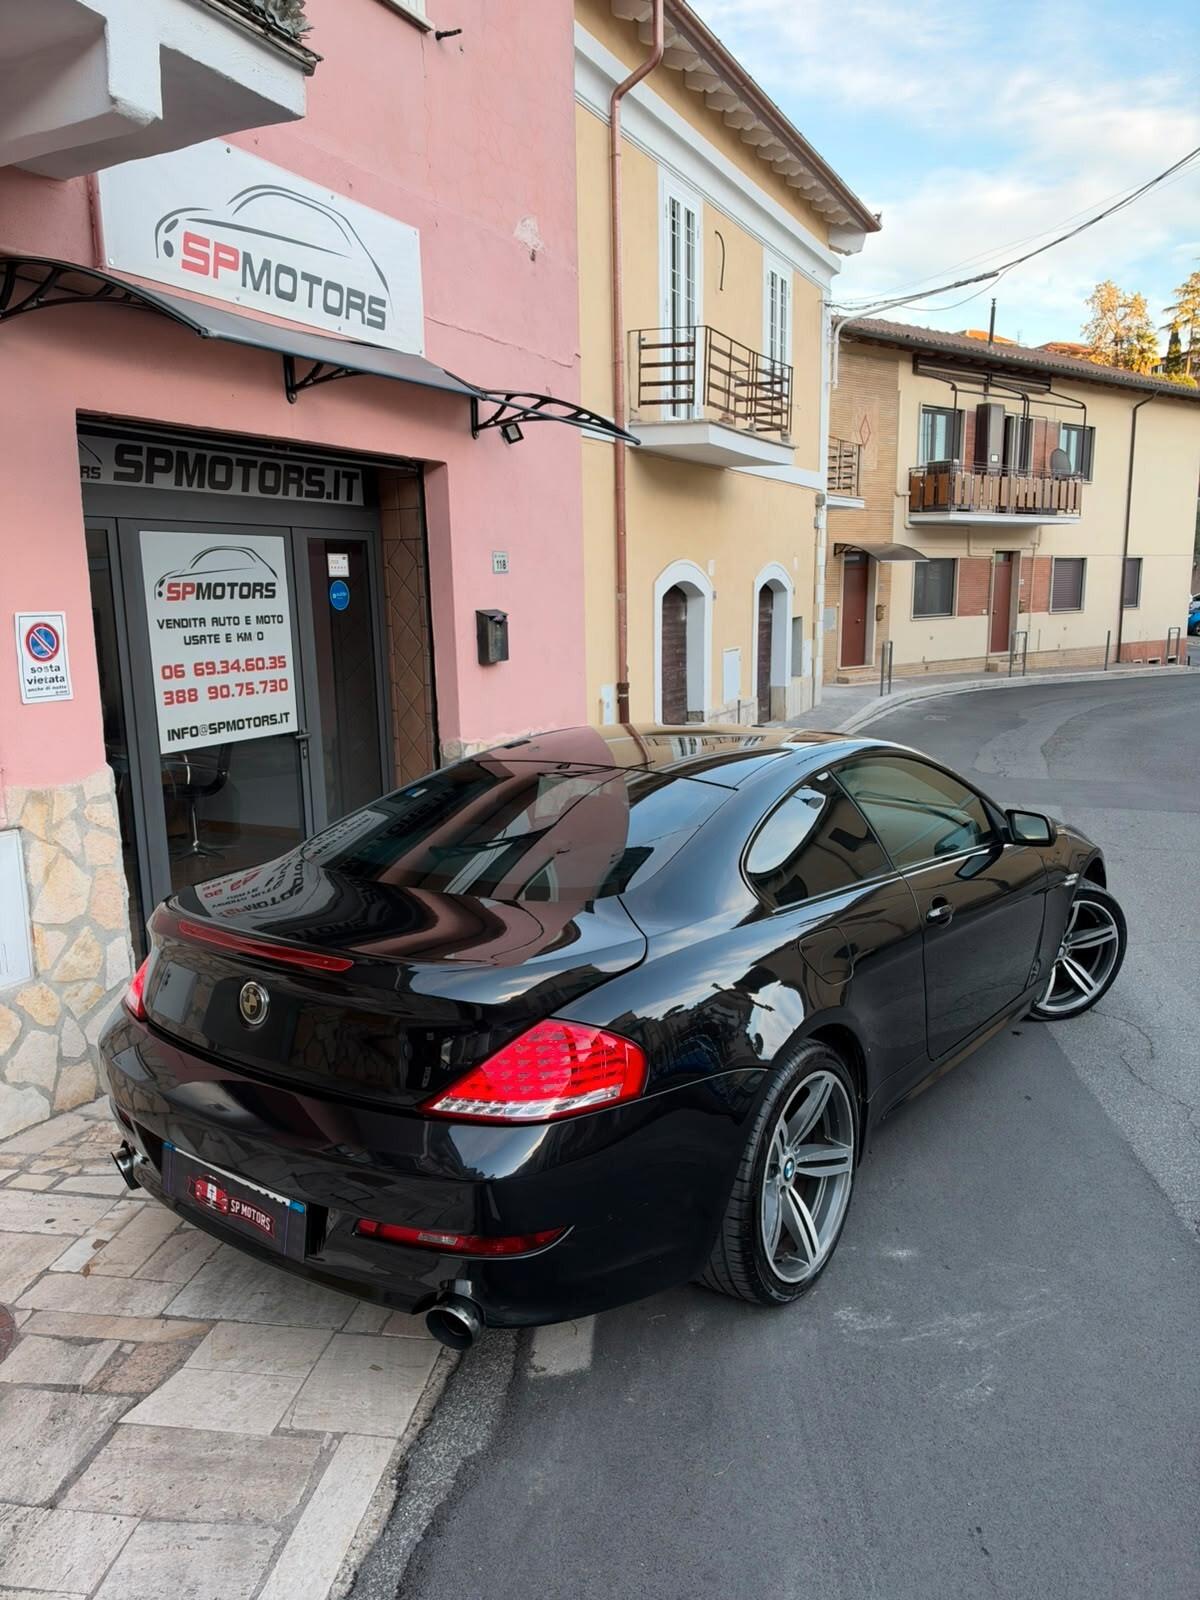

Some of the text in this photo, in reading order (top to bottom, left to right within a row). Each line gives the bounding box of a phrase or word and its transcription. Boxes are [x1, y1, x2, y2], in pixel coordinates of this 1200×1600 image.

[180, 230, 386, 331] SPMOTORS
[113, 443, 360, 502] SPMOTORS.IT
[496, 559, 506, 570] 118
[166, 582, 276, 601] SPMOTORS
[157, 614, 284, 629] VENDITA AUTO E MOTO
[183, 633, 221, 646] USATE
[225, 633, 232, 643] E
[237, 632, 252, 642] KM
[30, 664, 61, 674] sosta
[161, 655, 287, 680] 06 69.34.60.35
[26, 675, 65, 685] vietata
[163, 678, 289, 706] 388 90.75.730
[167, 712, 290, 741] INFO@SPMOTORS.IT
[230, 1199, 271, 1231] SP MOTORS
